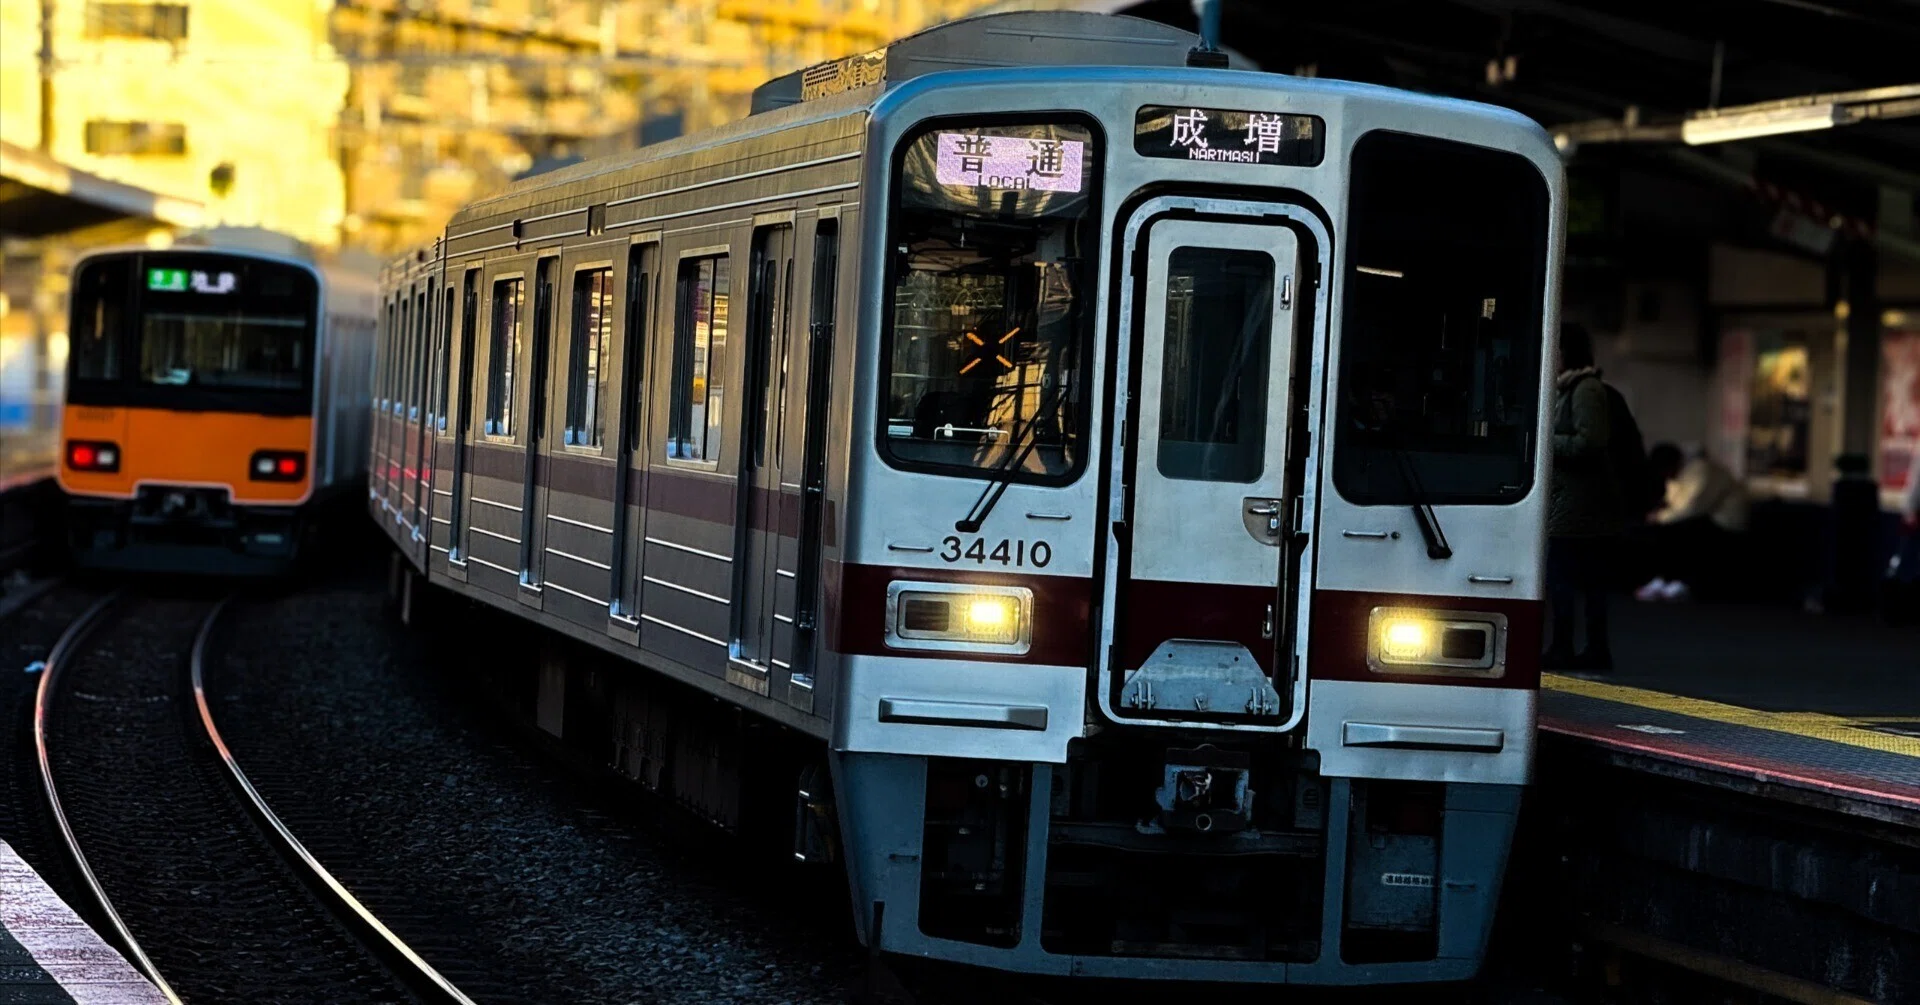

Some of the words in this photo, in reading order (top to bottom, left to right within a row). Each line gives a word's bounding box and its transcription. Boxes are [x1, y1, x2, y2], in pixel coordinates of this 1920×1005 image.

[1169, 109, 1283, 154] 成増
[953, 135, 1065, 178] 普通
[1188, 147, 1260, 163] NARIMASU
[977, 174, 1036, 190] LOCAL
[940, 535, 1052, 568] 34410
